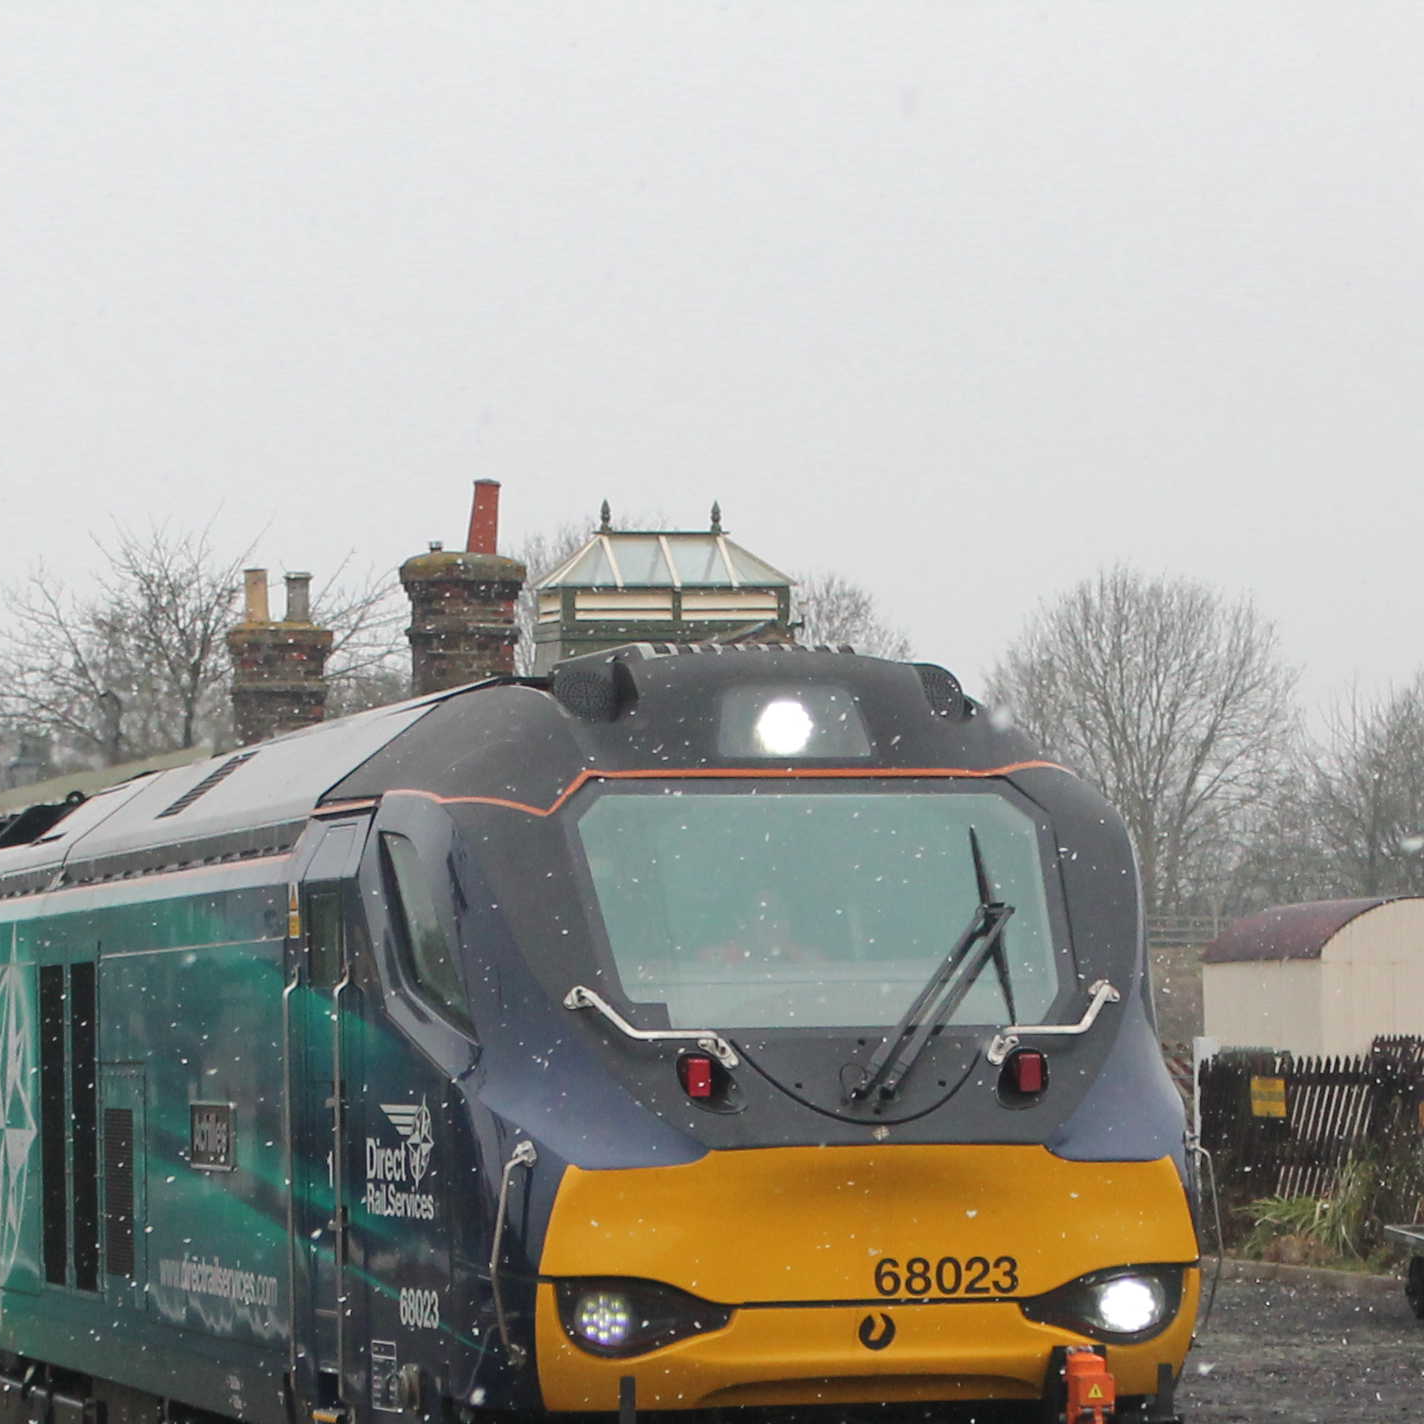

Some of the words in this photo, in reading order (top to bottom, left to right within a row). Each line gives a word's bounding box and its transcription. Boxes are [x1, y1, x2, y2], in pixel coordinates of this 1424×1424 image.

[365, 1136, 407, 1182] Direct
[873, 1255, 1020, 1297] 68023
[399, 1286, 440, 1329] 68023
